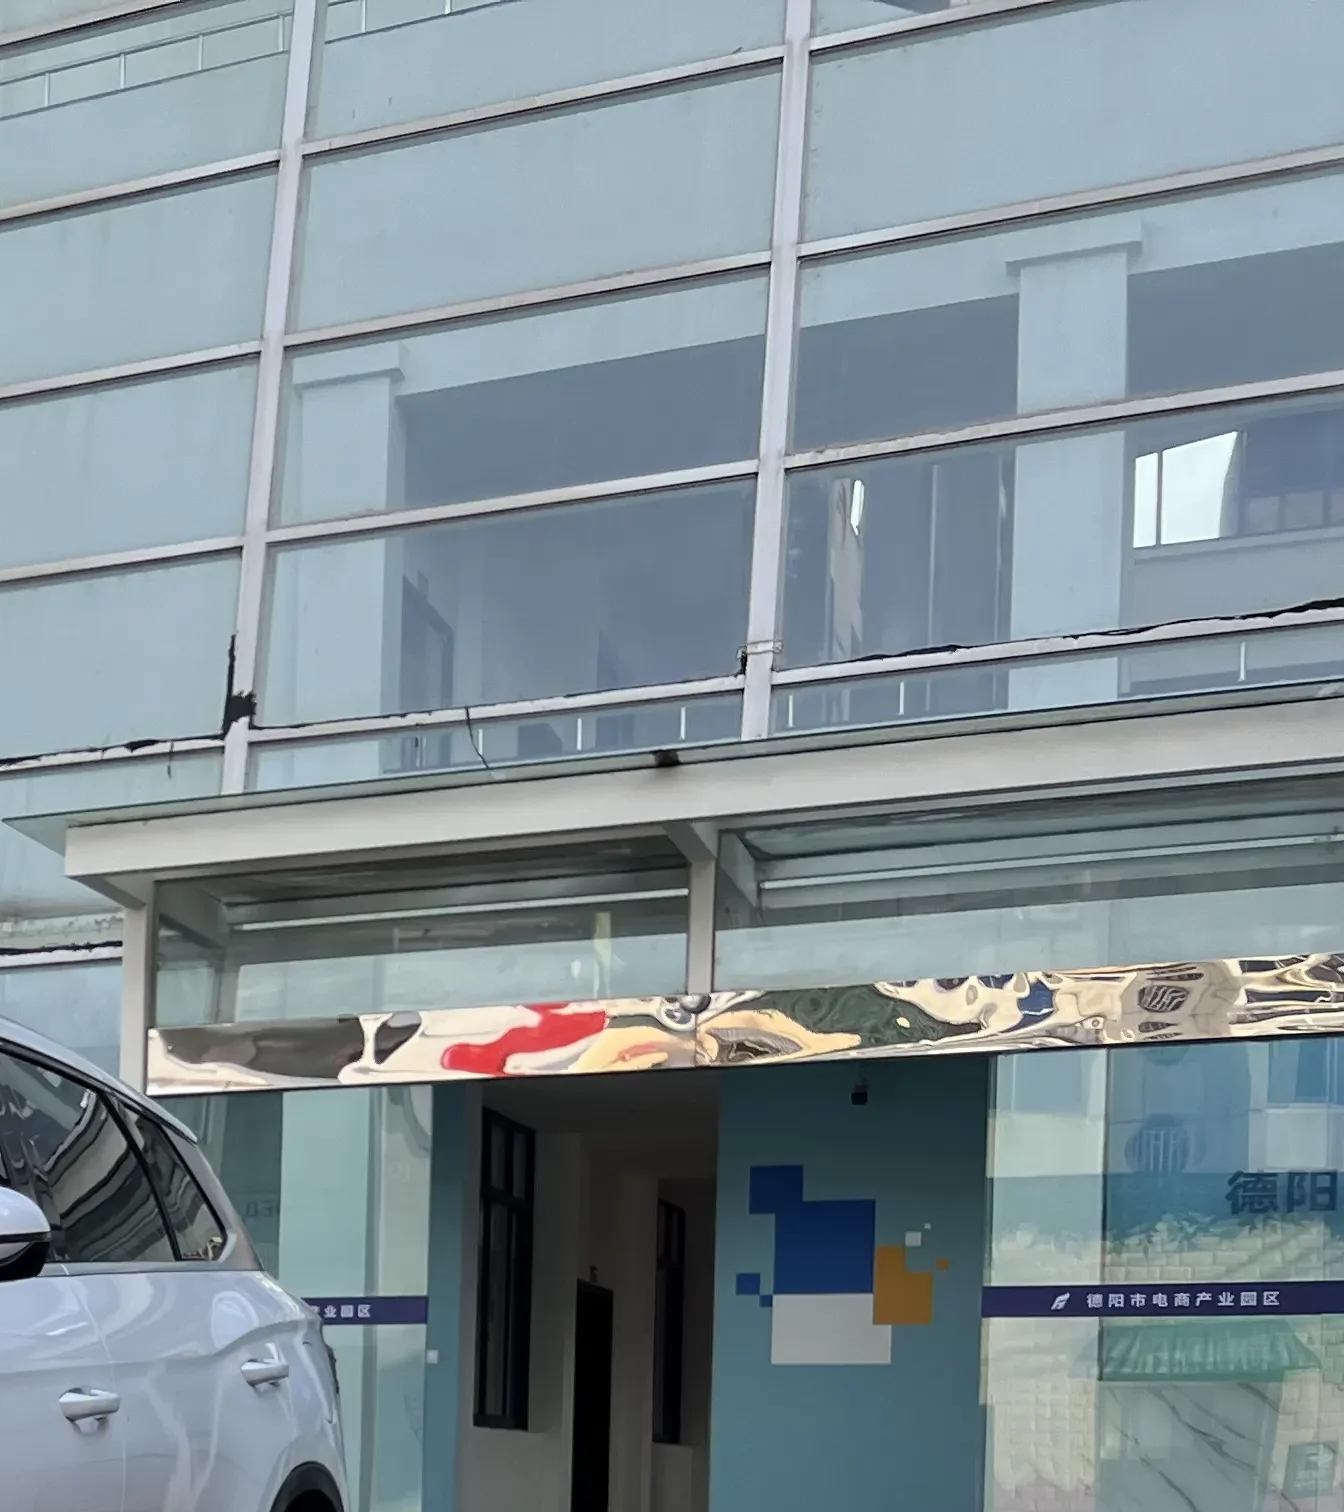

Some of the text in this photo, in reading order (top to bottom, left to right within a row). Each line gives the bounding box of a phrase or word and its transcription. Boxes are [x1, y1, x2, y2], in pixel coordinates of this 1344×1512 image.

[1225, 1170, 1338, 1214] 德阳
[1086, 1291, 1281, 1308] 德阳市电商产业园区
